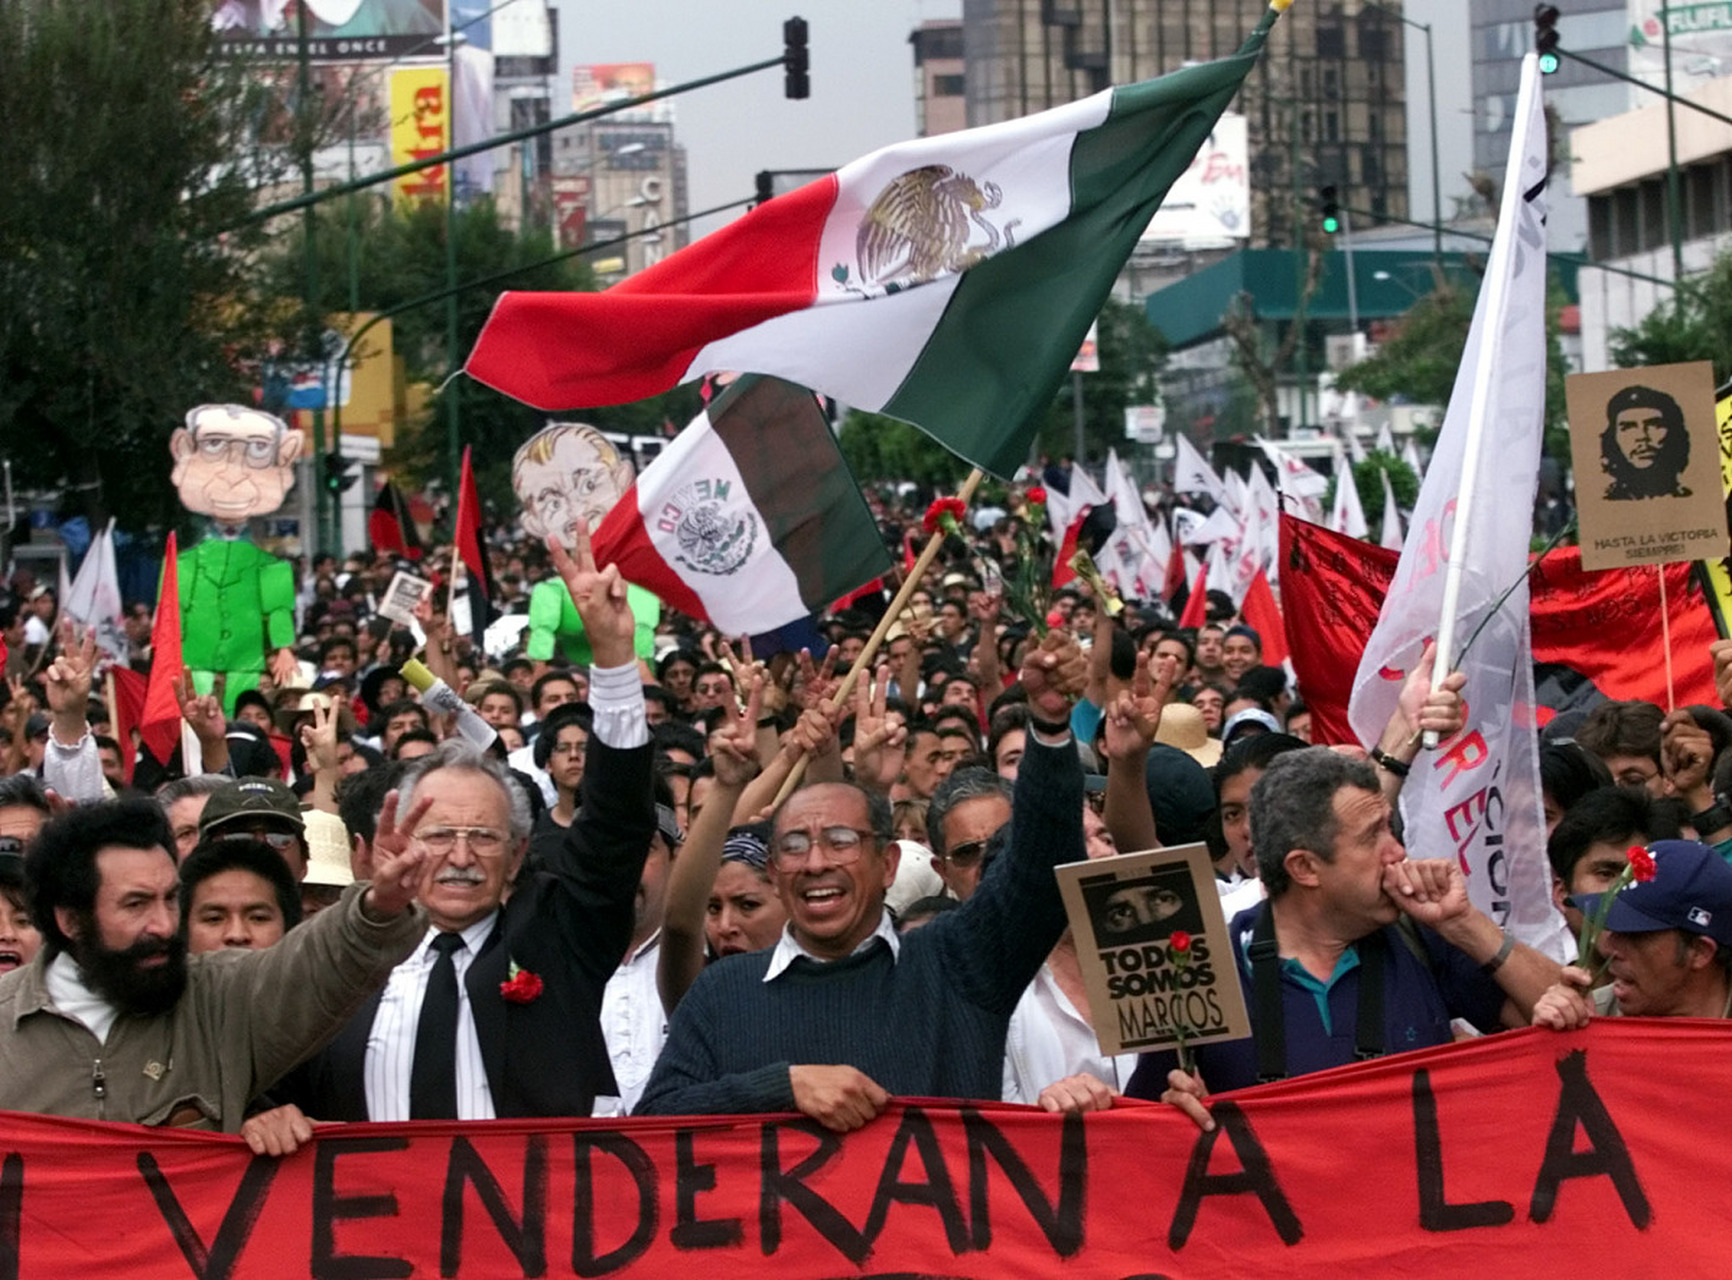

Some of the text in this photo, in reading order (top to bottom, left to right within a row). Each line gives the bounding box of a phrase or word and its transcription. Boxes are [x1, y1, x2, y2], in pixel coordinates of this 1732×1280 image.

[308, 41, 328, 54] EL
[336, 39, 387, 54] ONCE
[1594, 527, 1718, 551] HASTA LA VICTORIA
[1100, 938, 1211, 975] TODOS
[1107, 962, 1216, 1000] SOMOS
[1116, 988, 1223, 1040] MARCOS
[136, 1104, 1087, 1280] VENDERAN
[1167, 1100, 1304, 1252] A
[1411, 1047, 1656, 1232] LA
